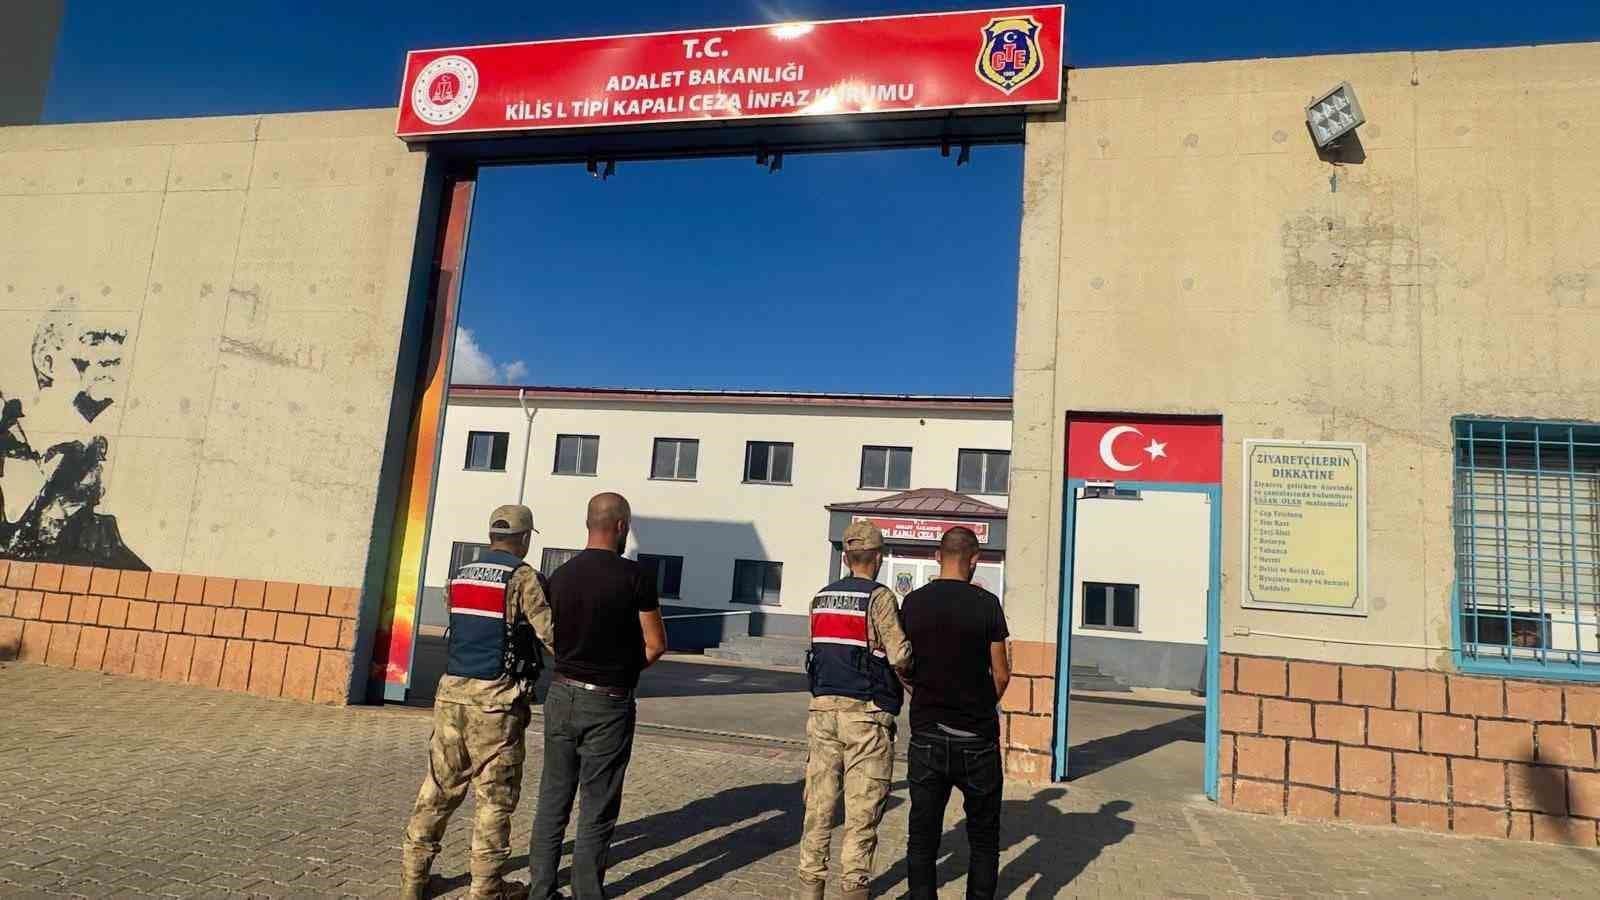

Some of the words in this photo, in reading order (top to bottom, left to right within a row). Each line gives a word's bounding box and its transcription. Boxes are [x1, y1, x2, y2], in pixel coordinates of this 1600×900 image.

[682, 37, 729, 59] T.C.
[605, 71, 685, 92] ADALET
[688, 62, 805, 86] BAKANLIĞI
[506, 100, 553, 121] KİLİS
[557, 102, 568, 118] L
[571, 97, 609, 118] TİPİ
[613, 95, 685, 116] KAPALI
[689, 91, 742, 112] CEZA
[747, 88, 810, 110] İNFAZ
[457, 567, 504, 582] JANDARMA
[815, 595, 861, 611] JANDARMA
